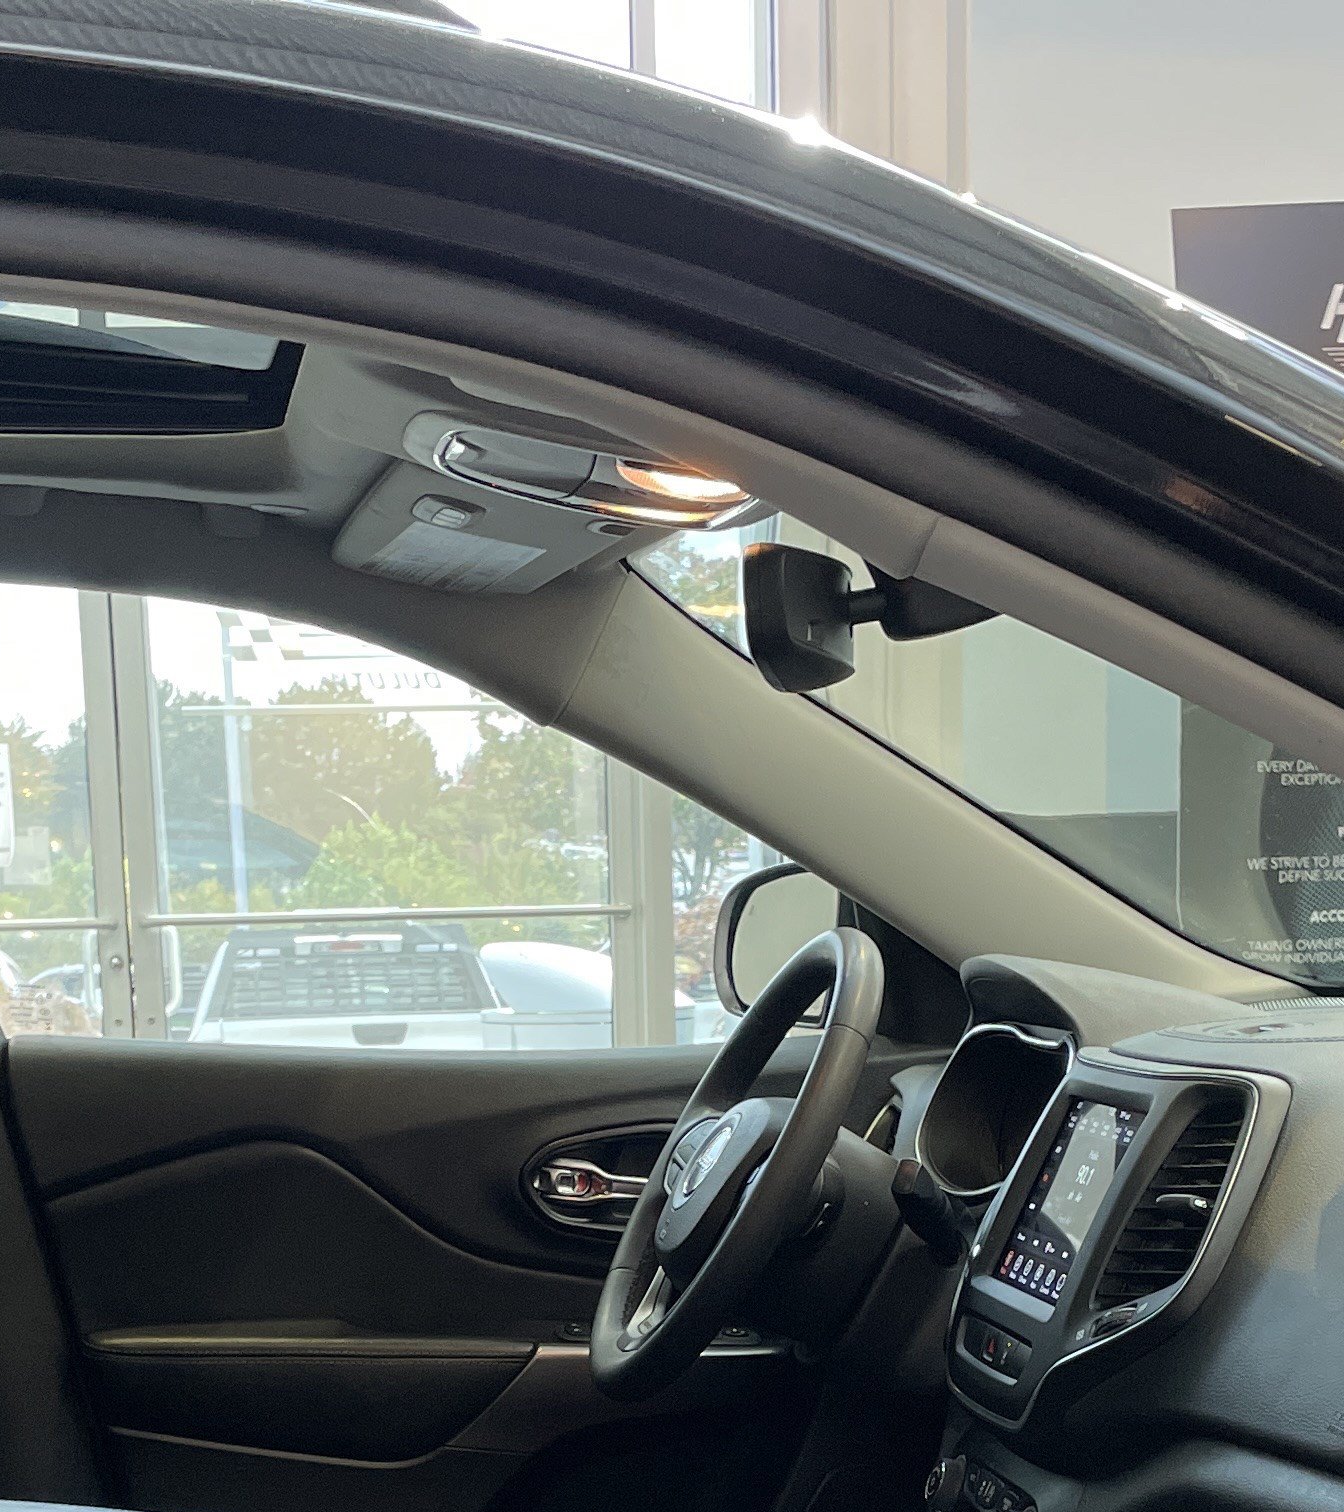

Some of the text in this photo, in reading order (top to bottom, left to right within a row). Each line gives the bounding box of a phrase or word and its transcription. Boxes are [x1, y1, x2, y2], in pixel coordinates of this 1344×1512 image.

[1256, 760, 1294, 773] EVERY
[1246, 857, 1268, 871] WE
[1270, 855, 1311, 871] STRIVE
[1312, 853, 1330, 870] TO
[1247, 939, 1293, 951] TAKING
